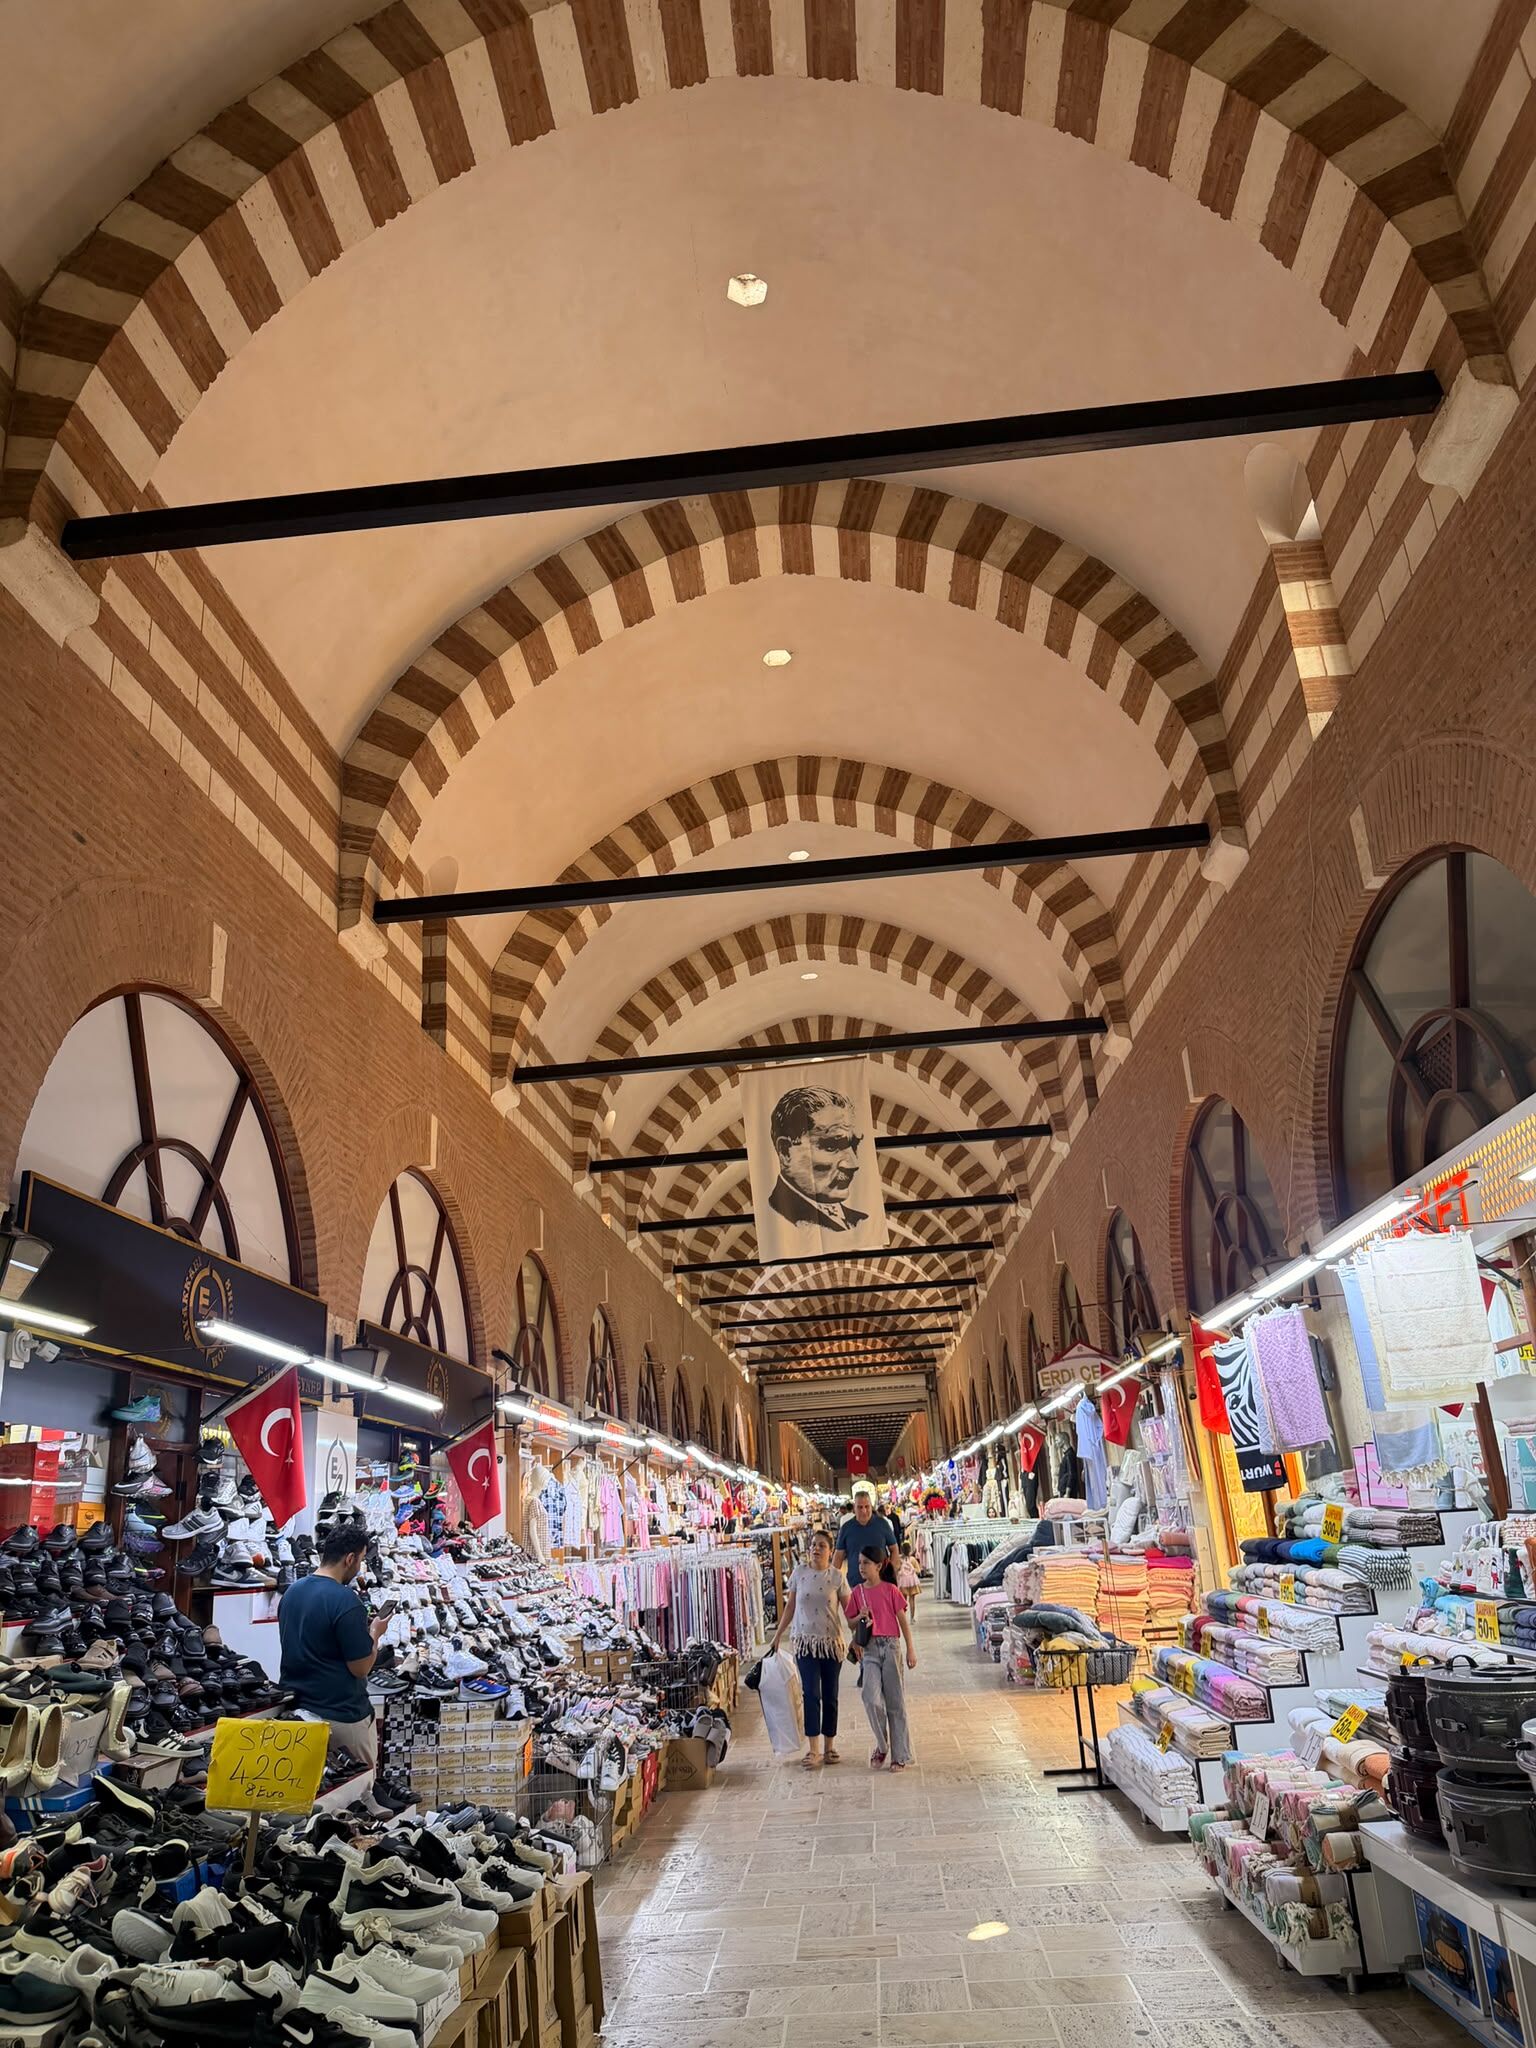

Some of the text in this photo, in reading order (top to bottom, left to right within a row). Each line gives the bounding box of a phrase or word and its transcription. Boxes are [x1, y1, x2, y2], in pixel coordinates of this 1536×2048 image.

[1477, 1617, 1497, 1640] 50TL
[239, 1726, 312, 1752] SPOR
[1333, 1716, 1352, 1741] 150TL
[245, 1783, 285, 1798] 8 Euro
